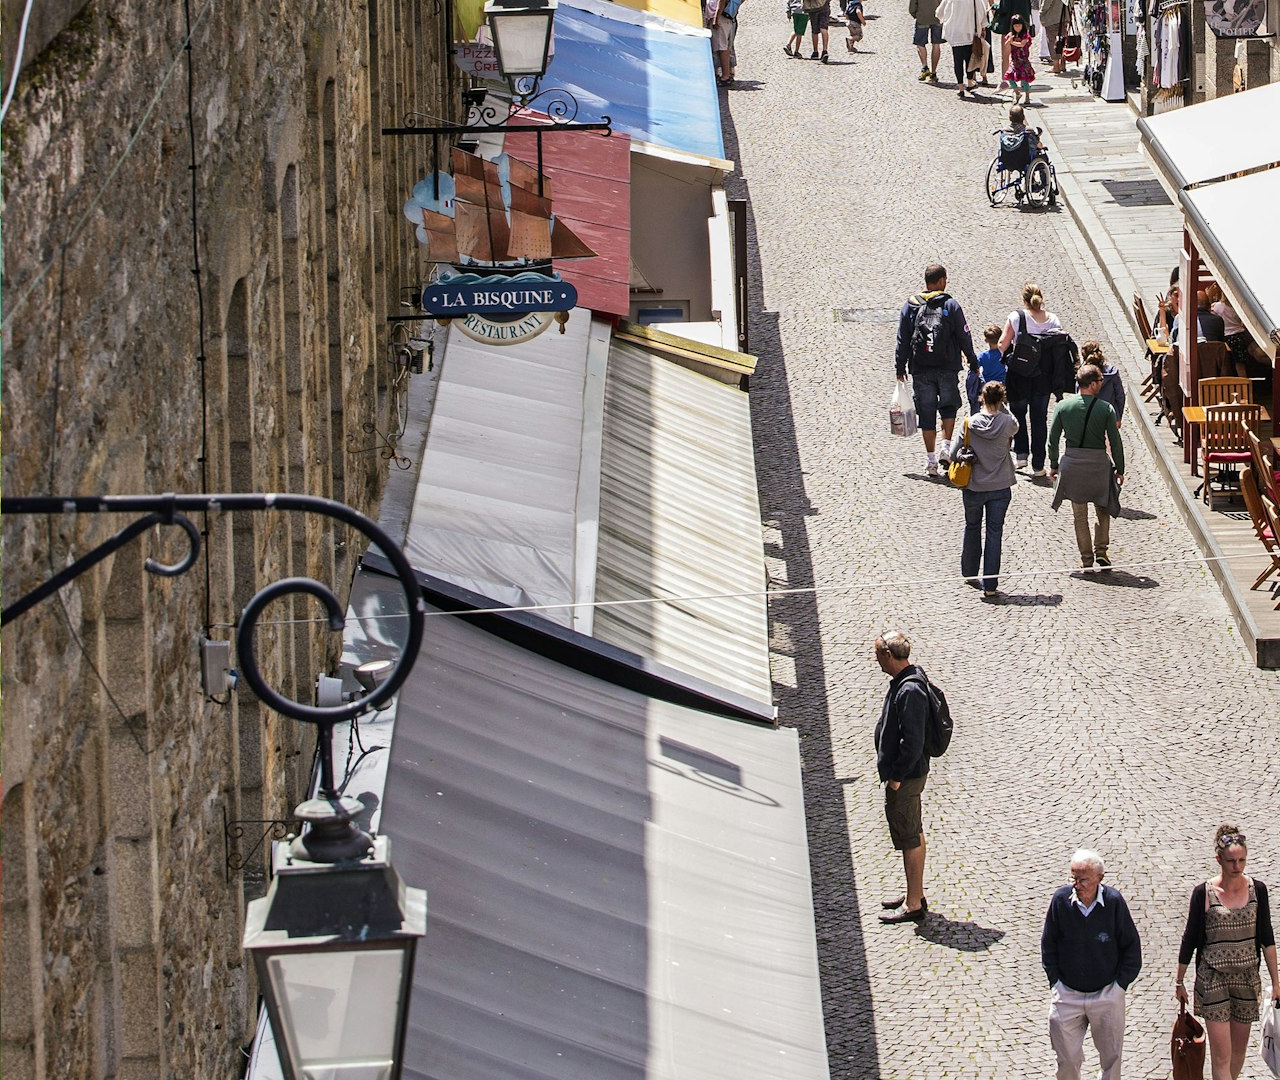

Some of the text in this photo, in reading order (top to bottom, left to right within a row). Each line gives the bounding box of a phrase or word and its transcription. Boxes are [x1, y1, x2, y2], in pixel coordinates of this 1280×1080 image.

[1219, 27, 1256, 37] POTIER
[442, 289, 555, 309] LA BISQUINE
[464, 313, 543, 340] RESTAURANT
[925, 326, 934, 353] FILA
